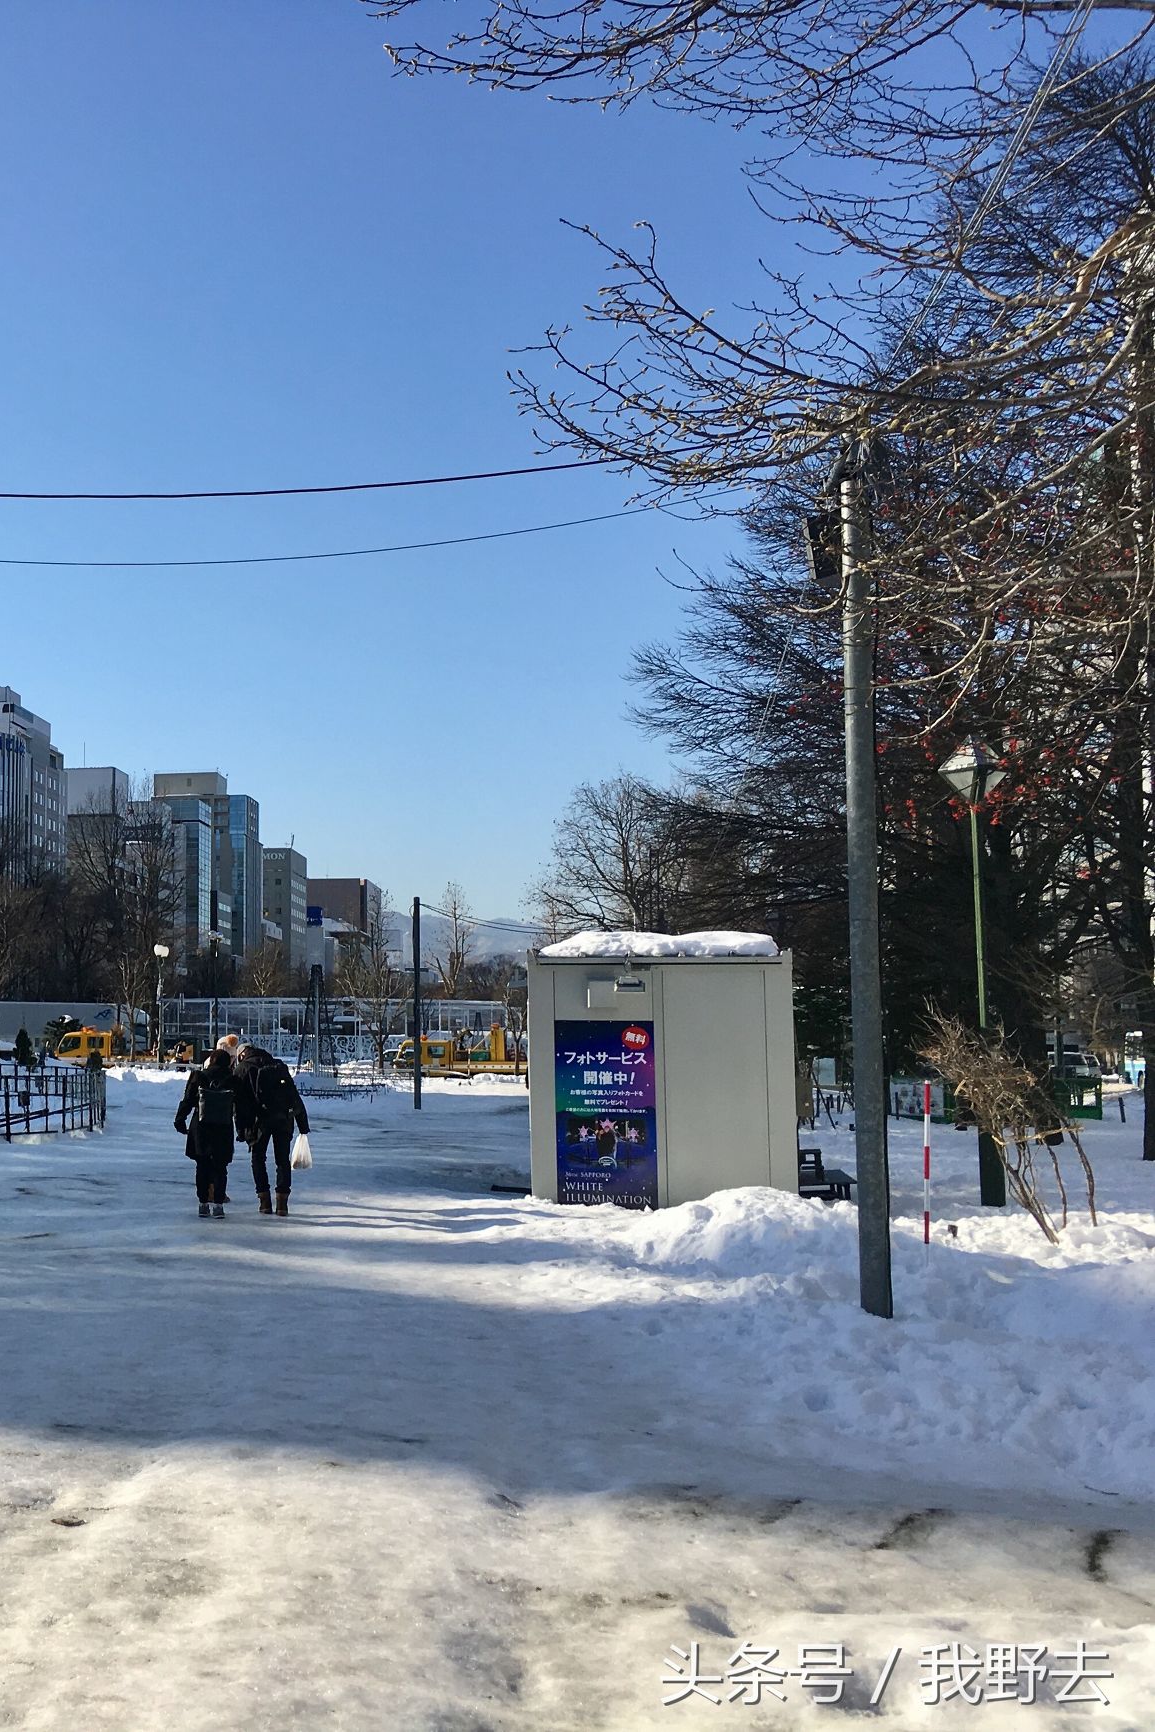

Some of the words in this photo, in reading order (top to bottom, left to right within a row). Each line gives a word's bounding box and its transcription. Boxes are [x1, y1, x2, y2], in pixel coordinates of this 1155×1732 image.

[624, 1031, 646, 1045] 無料
[564, 1051, 647, 1066] フォトサービス
[565, 1181, 603, 1192] WHITE
[566, 1193, 651, 1205] ILLUMINATION
